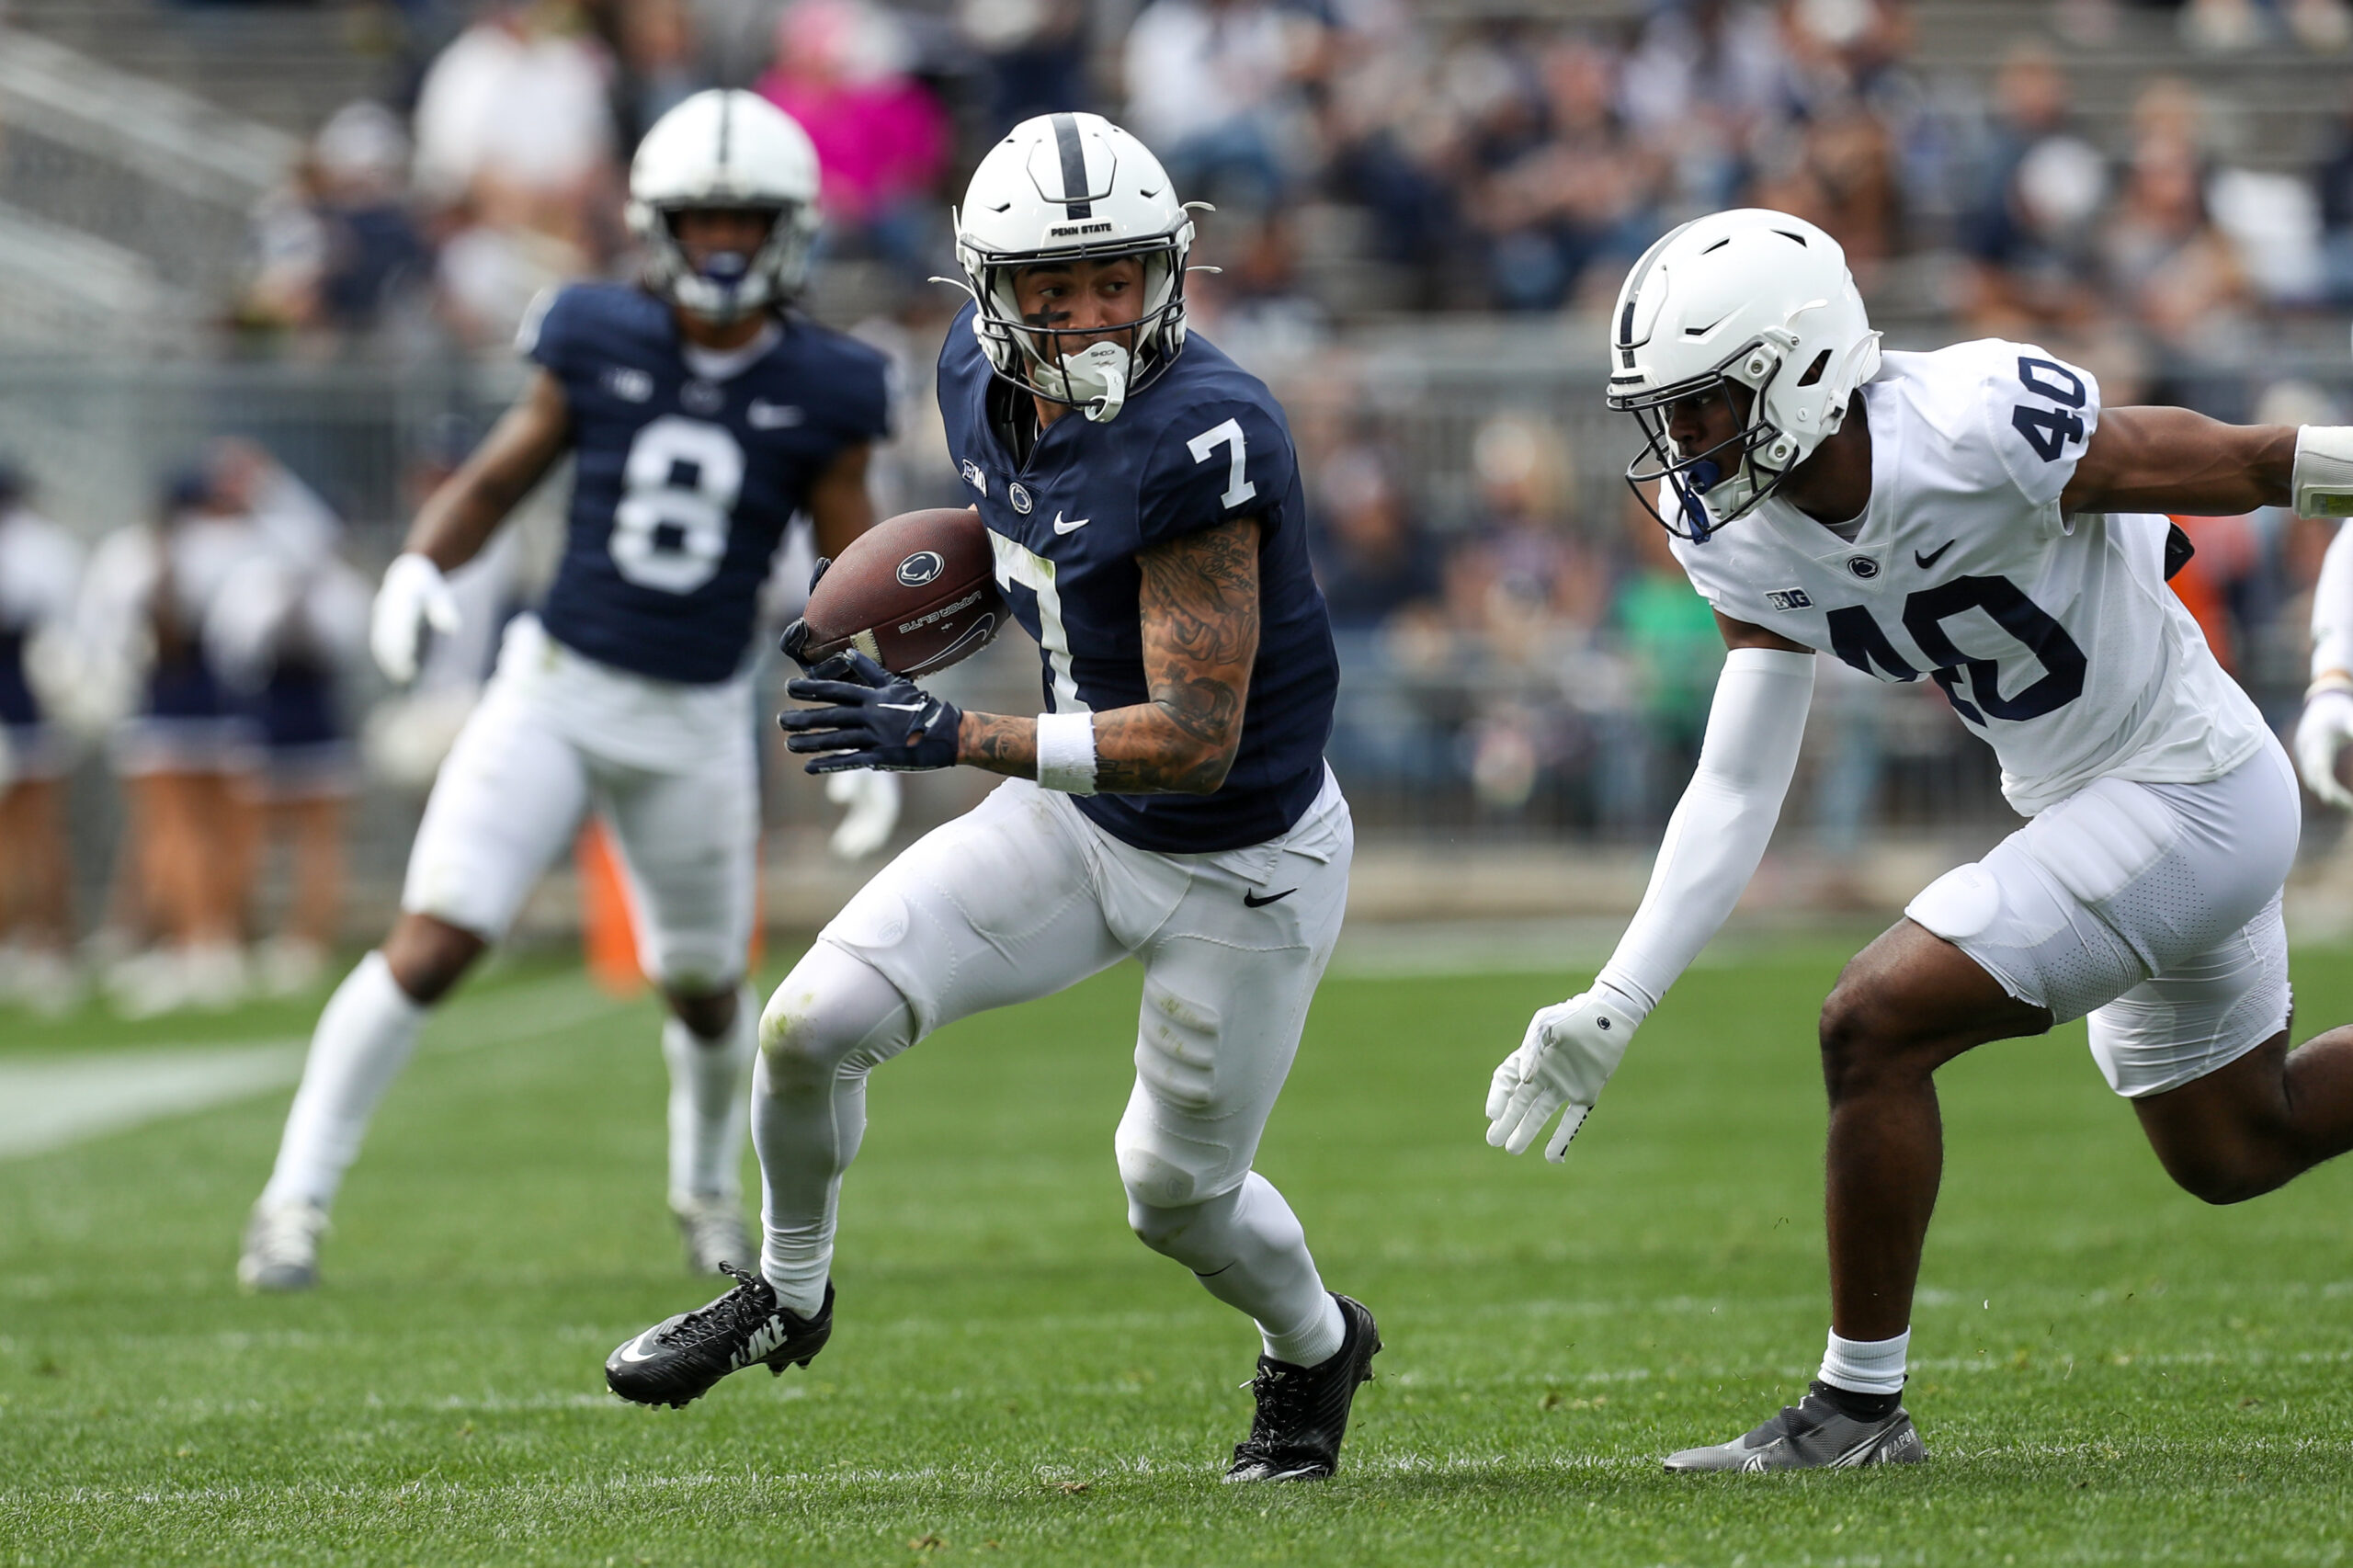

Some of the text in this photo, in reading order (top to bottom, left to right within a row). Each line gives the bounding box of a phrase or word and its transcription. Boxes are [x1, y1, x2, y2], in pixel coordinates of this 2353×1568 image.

[1051, 222, 1112, 237] PENN STATE
[2012, 357, 2086, 462] 40
[608, 414, 746, 596] 8
[1186, 417, 1256, 509] 7
[898, 611, 940, 634] ELITE
[940, 590, 982, 619] VAPOR
[987, 527, 1094, 714] 7
[1826, 574, 2087, 728] 40
